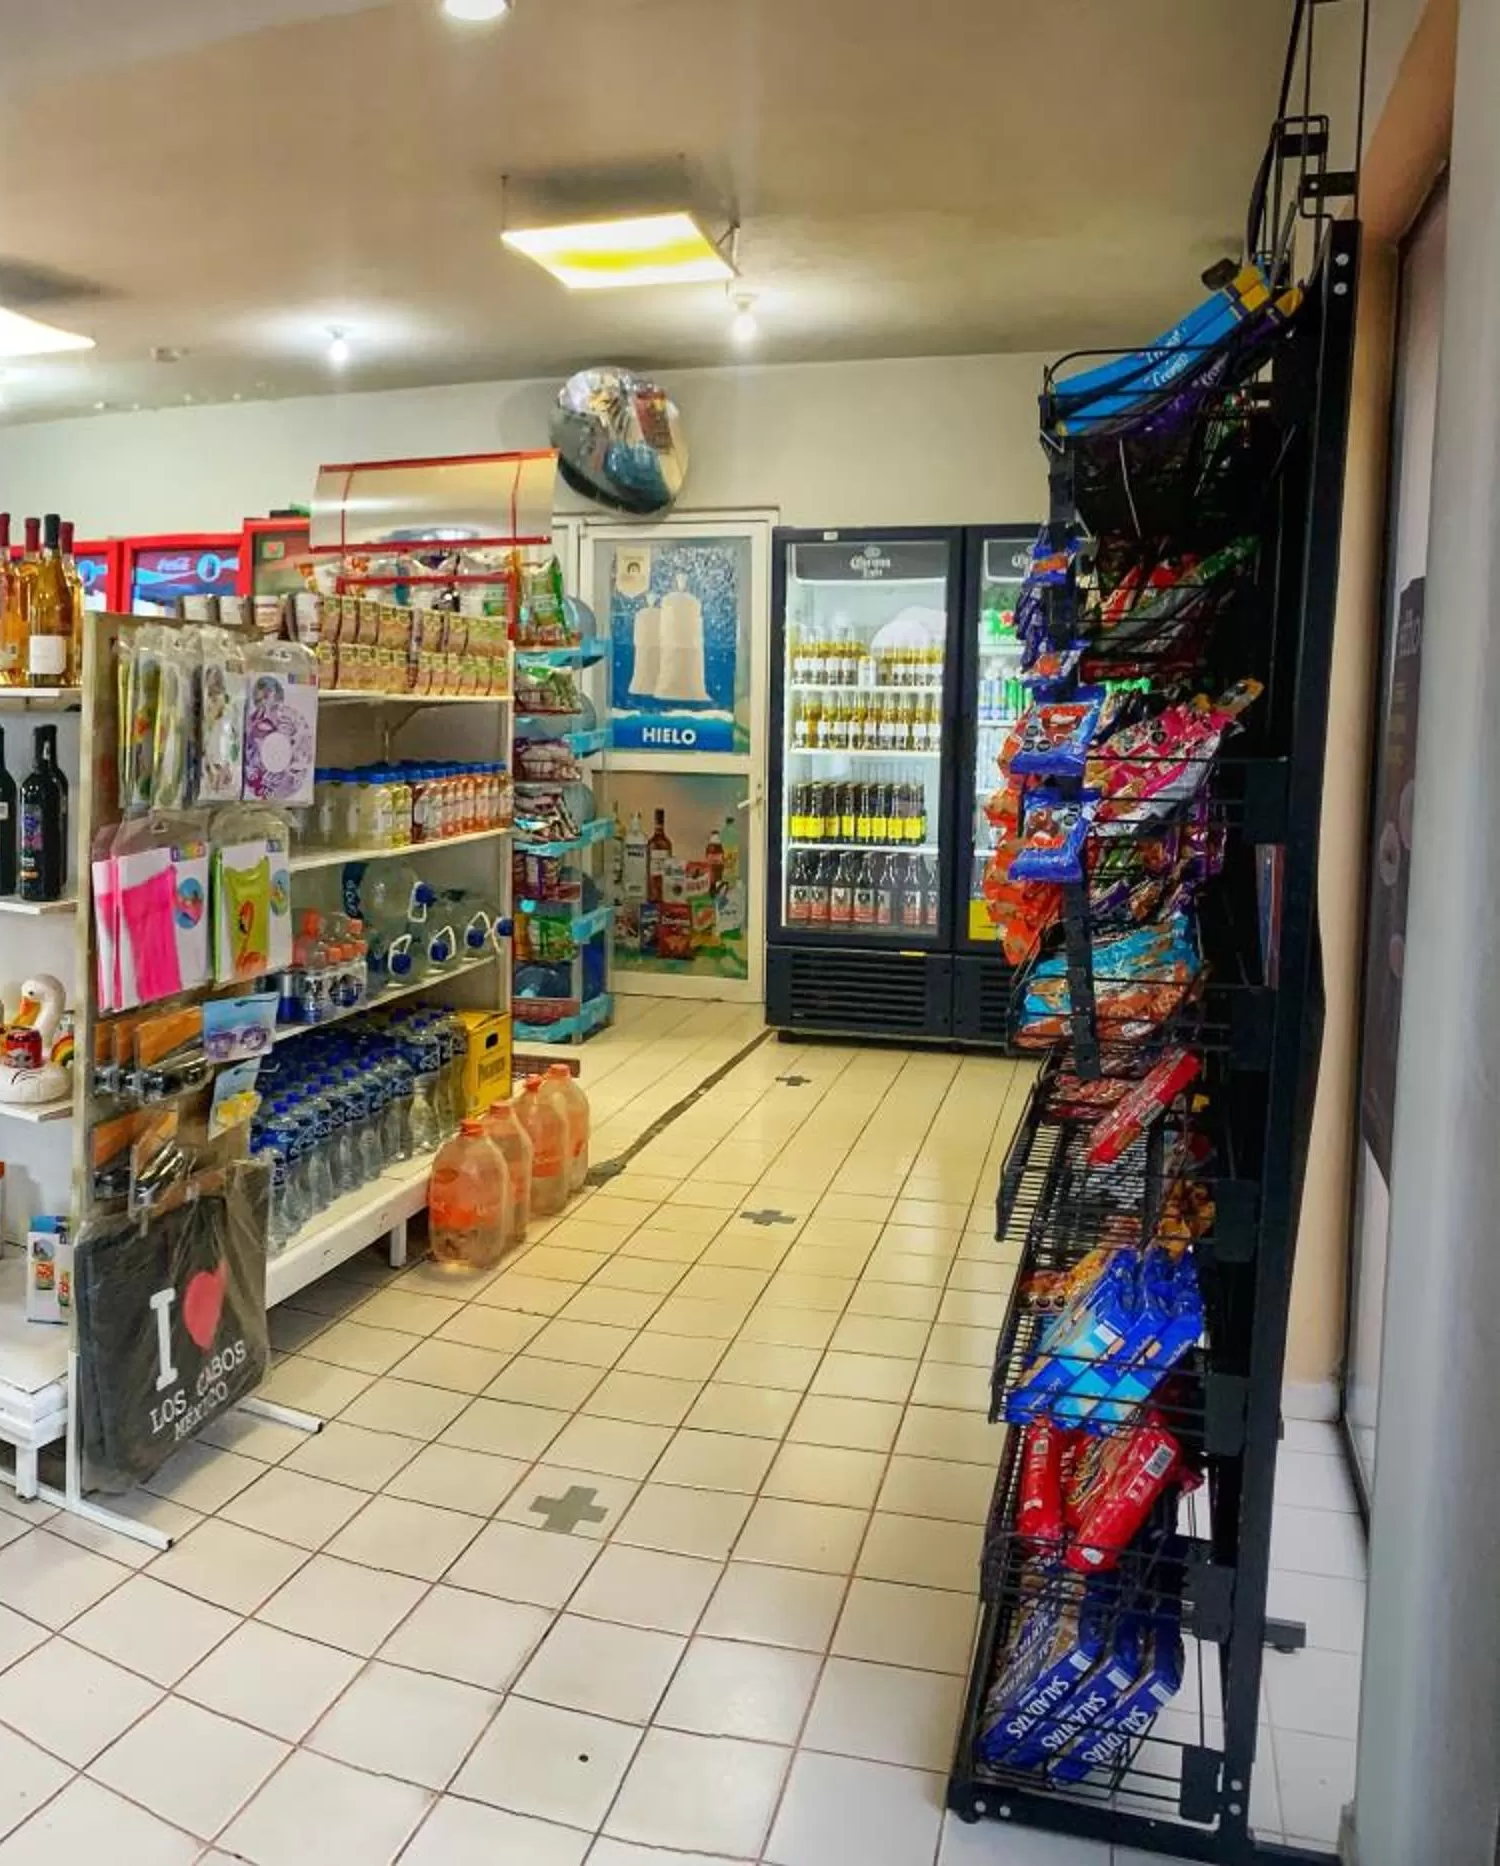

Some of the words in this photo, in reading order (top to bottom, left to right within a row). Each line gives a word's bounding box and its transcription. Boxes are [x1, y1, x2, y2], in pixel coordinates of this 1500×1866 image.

[642, 727, 697, 745] HIELO
[149, 1287, 178, 1392] I
[149, 1388, 187, 1434] LOS
[196, 1339, 247, 1397] CABOS
[1006, 1675, 1070, 1740] SALADTAS
[1081, 1705, 1151, 1764] SALDITAS
